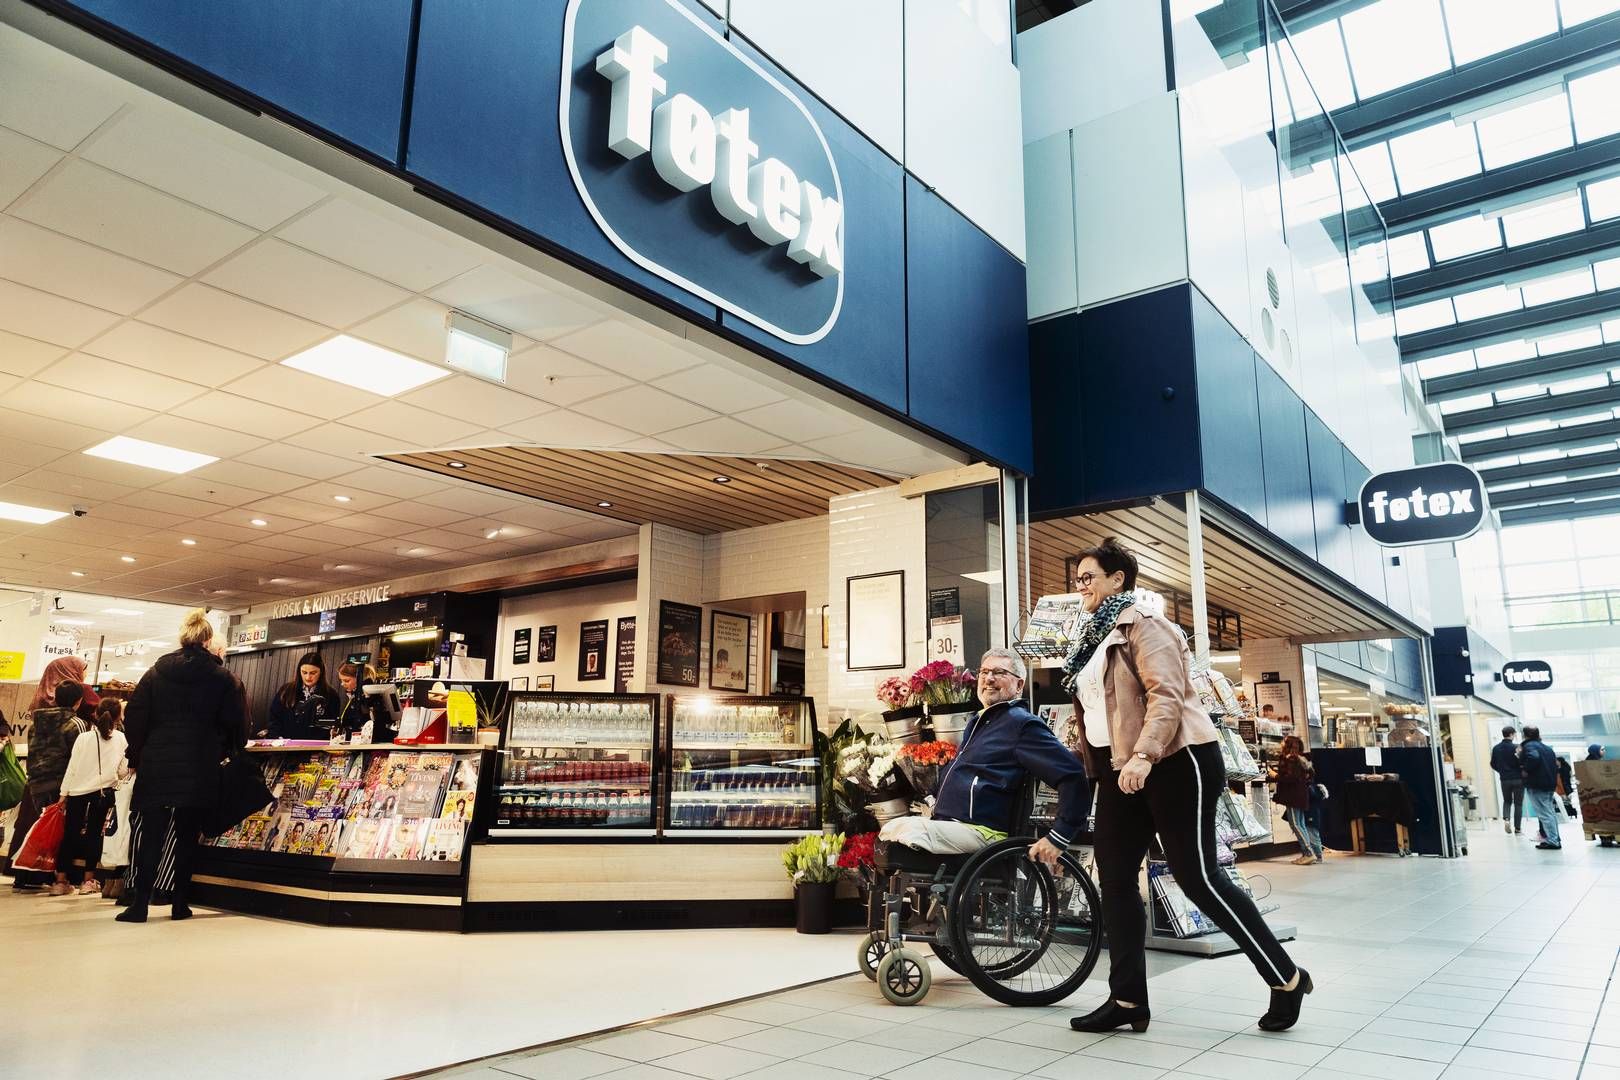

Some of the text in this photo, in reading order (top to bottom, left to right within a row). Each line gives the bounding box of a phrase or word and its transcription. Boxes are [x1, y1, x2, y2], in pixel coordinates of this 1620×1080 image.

[595, 25, 841, 277] føtex
[1368, 486, 1475, 524] føtex
[272, 585, 391, 619] KIOSK & KUNDESERVICE
